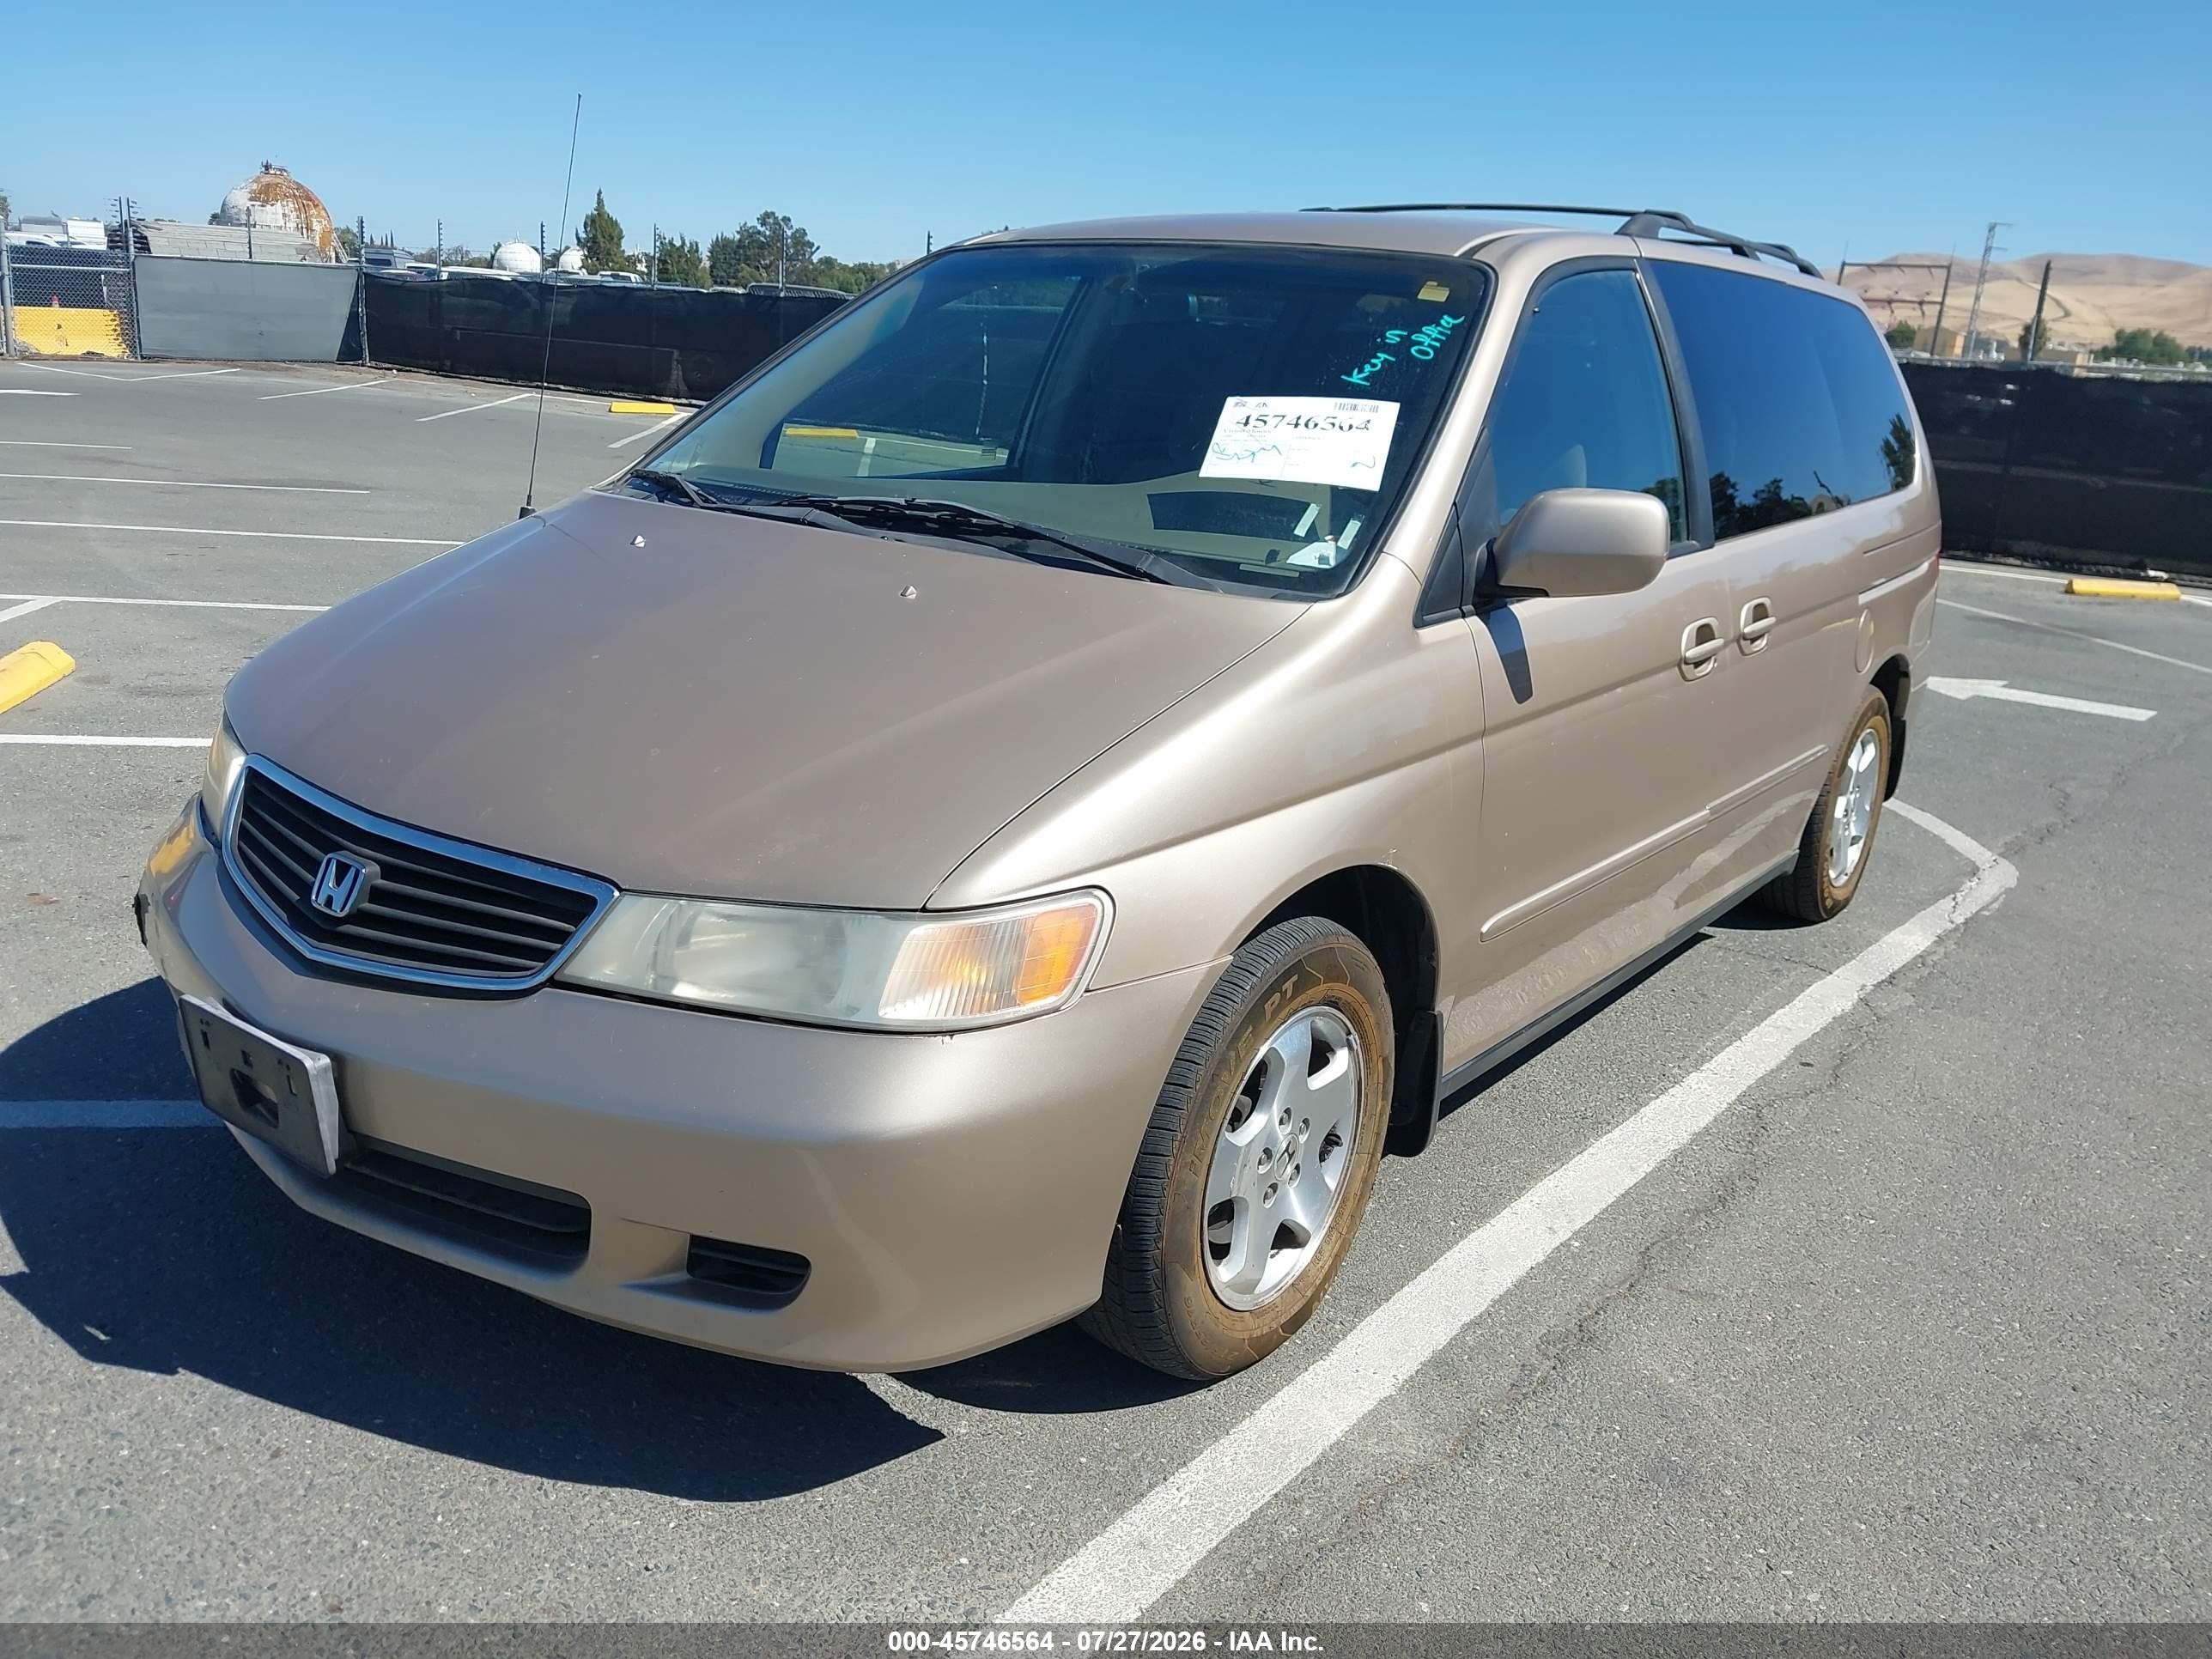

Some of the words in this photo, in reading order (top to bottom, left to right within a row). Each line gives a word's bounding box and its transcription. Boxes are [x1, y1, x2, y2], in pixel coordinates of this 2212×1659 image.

[1340, 352, 1396, 386] Key
[1236, 414, 1371, 433] 45746564
[1264, 974, 1298, 1022] PT
